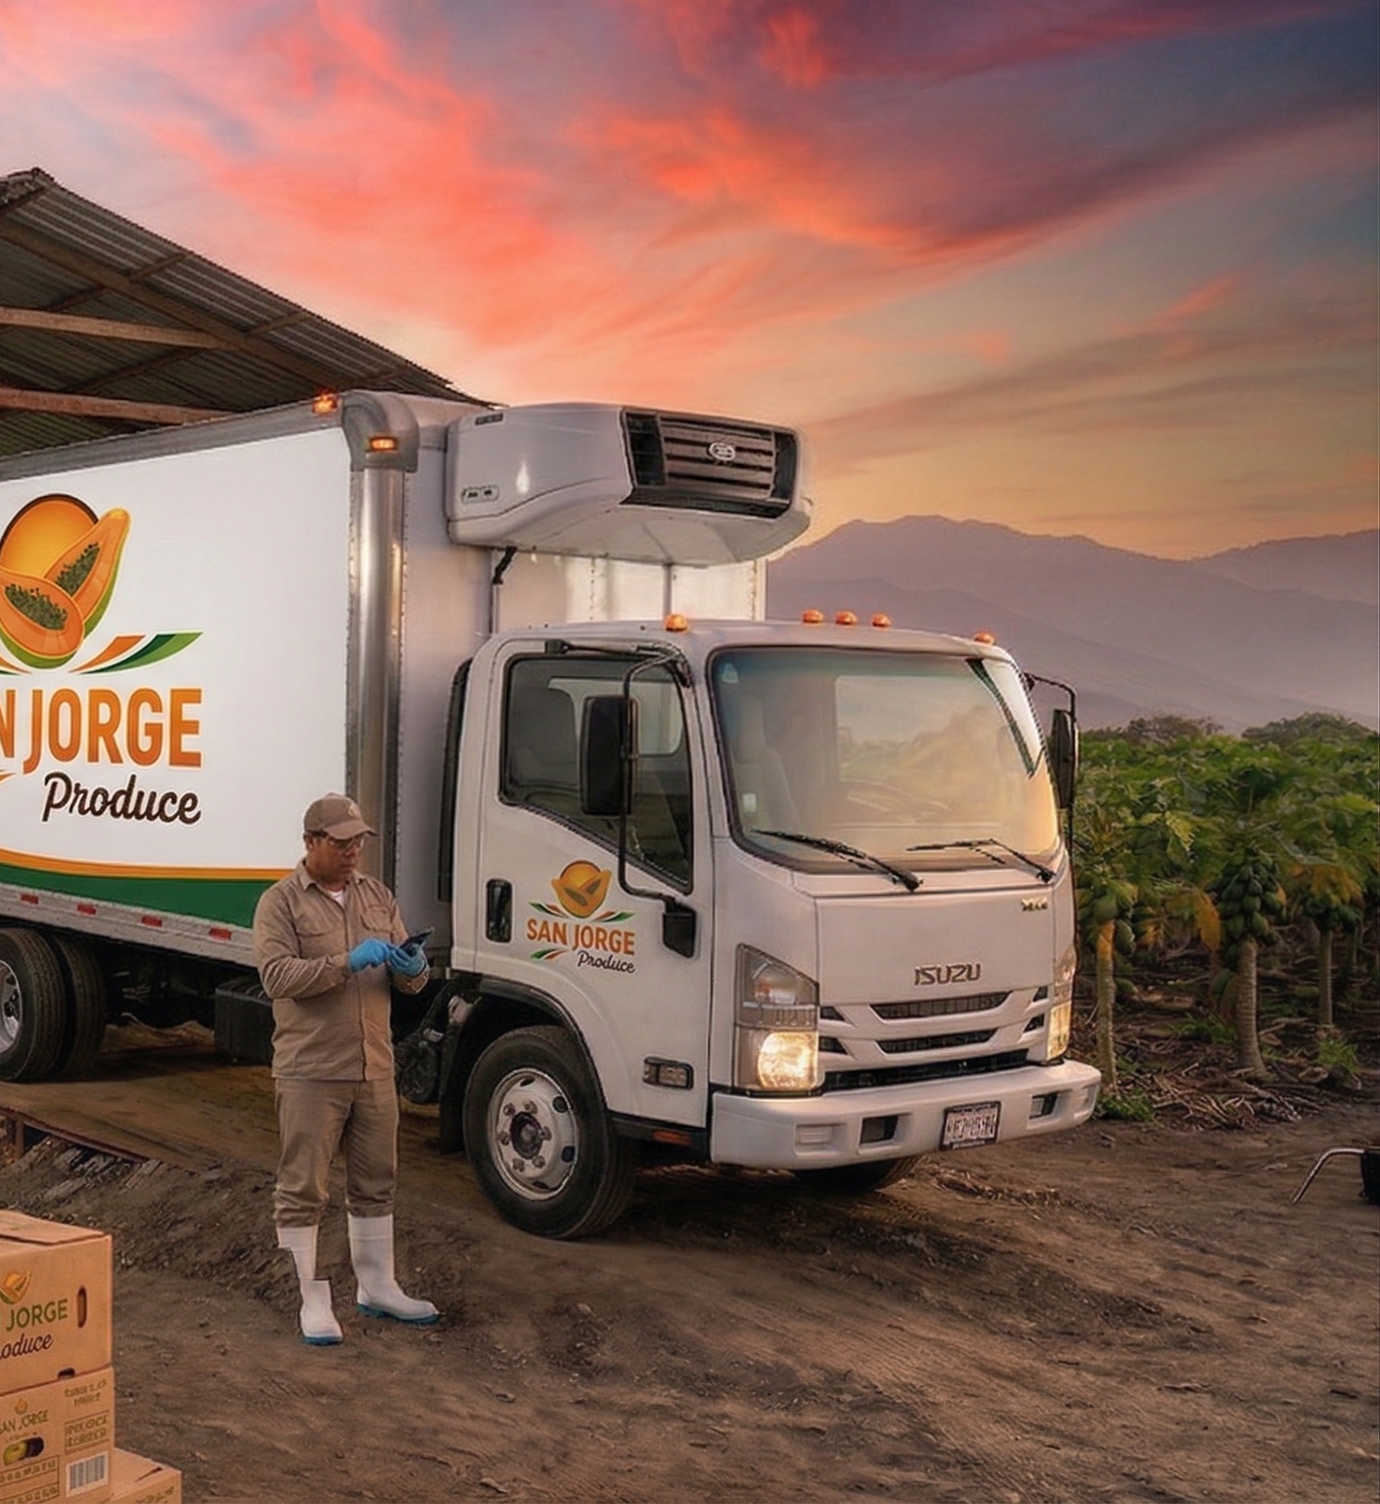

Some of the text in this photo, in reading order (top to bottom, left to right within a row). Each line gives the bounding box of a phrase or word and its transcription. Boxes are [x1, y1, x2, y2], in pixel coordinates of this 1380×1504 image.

[22, 687, 203, 776] JORGE
[41, 771, 202, 825] Produce
[527, 918, 635, 956] SAN JORGE
[577, 950, 636, 974] Produce
[914, 963, 981, 986] ISUZU
[6, 1298, 69, 1332] JORGE
